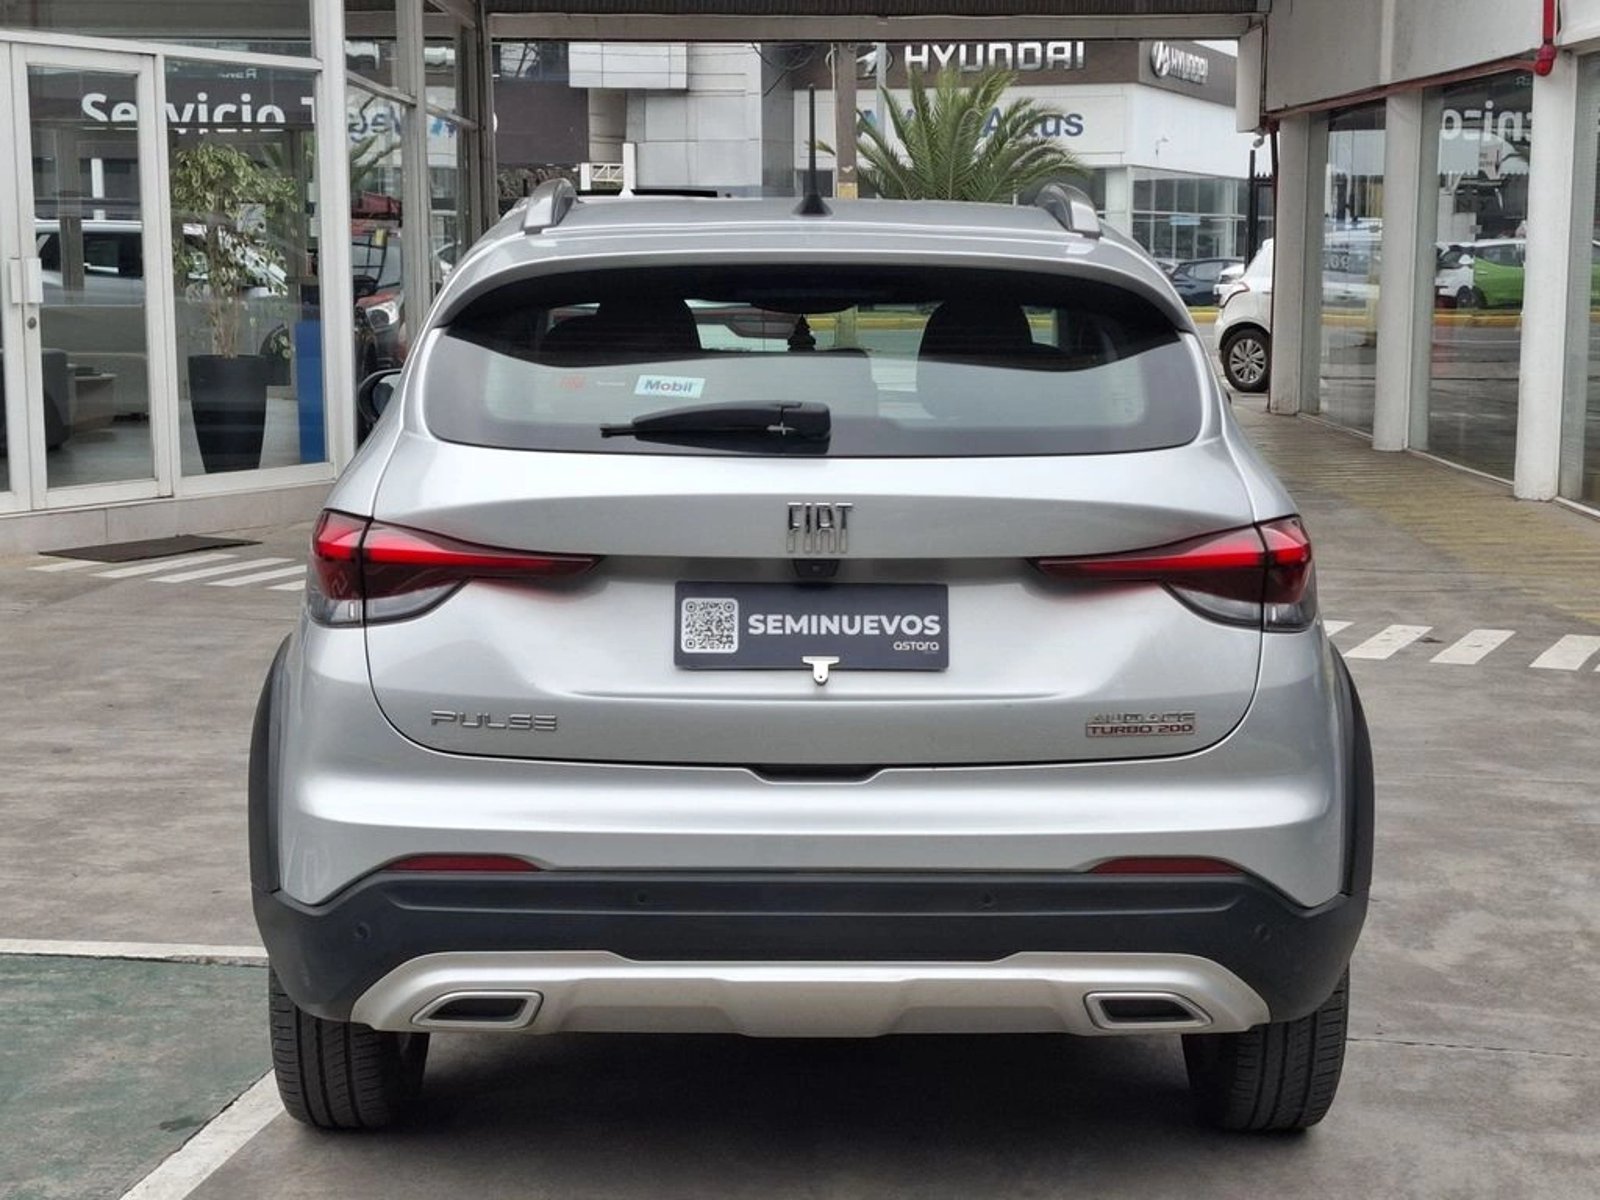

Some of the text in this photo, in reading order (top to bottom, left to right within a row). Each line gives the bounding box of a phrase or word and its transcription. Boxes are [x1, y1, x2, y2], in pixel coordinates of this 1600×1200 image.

[904, 41, 1084, 71] HYUNDAI
[81, 92, 286, 133] Sevicio
[644, 380, 693, 393] Mobil
[786, 502, 853, 554] FIAT
[748, 614, 941, 636] SEMINUEVOS
[893, 641, 940, 651] astara
[431, 710, 557, 731] PULSE
[1089, 724, 1194, 735] TURBO 200
